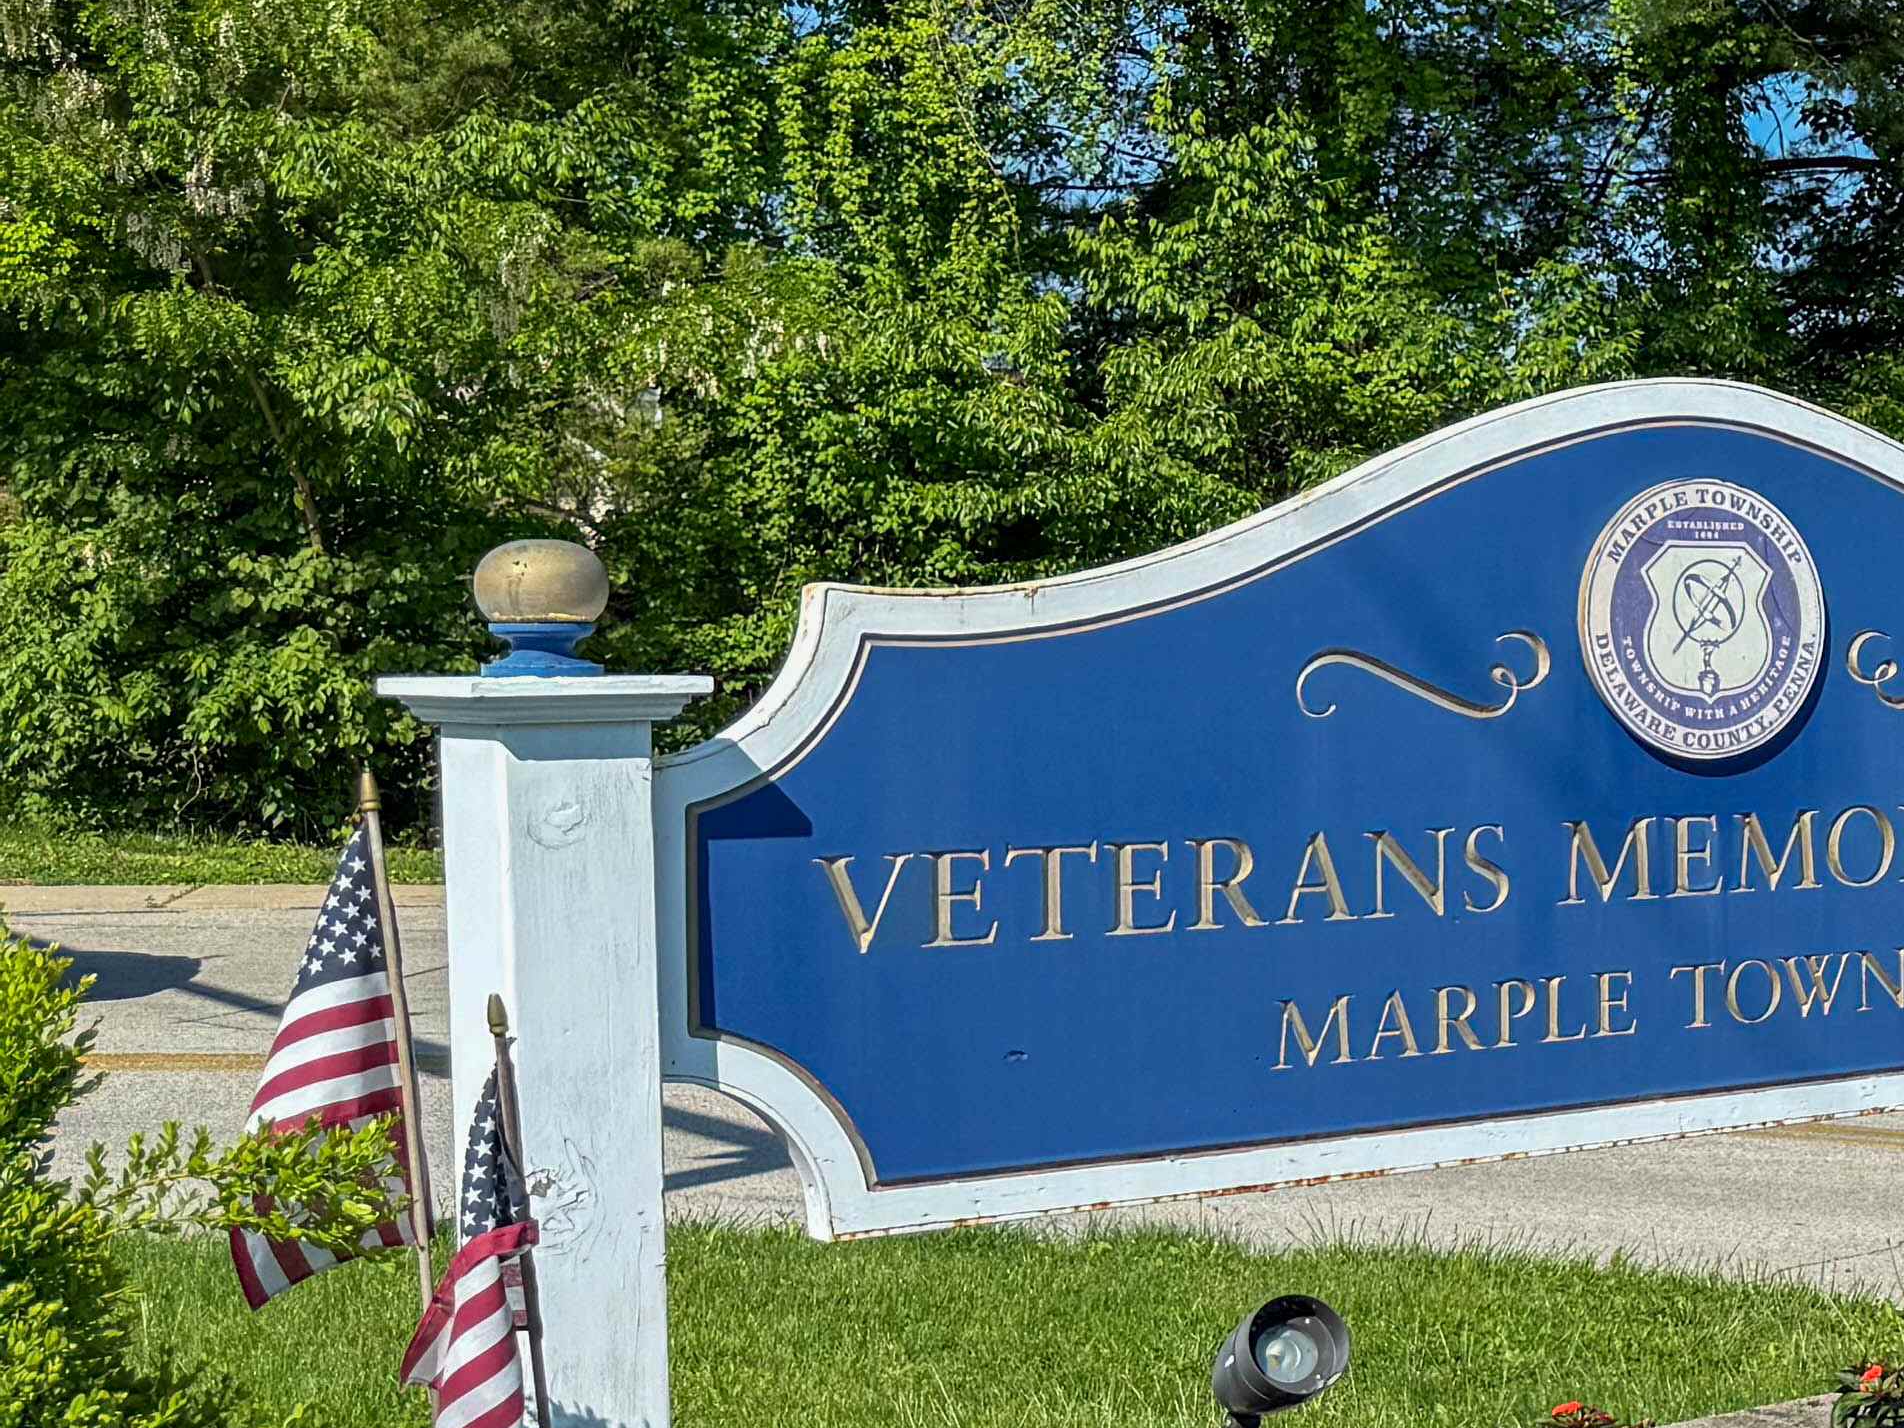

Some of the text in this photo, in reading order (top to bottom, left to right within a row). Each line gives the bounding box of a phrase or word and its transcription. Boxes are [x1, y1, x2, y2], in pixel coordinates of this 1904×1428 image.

[1606, 489, 1802, 565] MARPLE TOWNSHIP
[1667, 520, 1745, 531] ESTABLISHED
[1596, 633, 1676, 741] DELAWARE
[1773, 633, 1816, 715] PENNA.
[1622, 635, 1791, 720] TOWNSHIP WITH A HERITAGE
[812, 823, 1510, 954] VETERANS
[1270, 970, 1638, 1071] MARPLE
